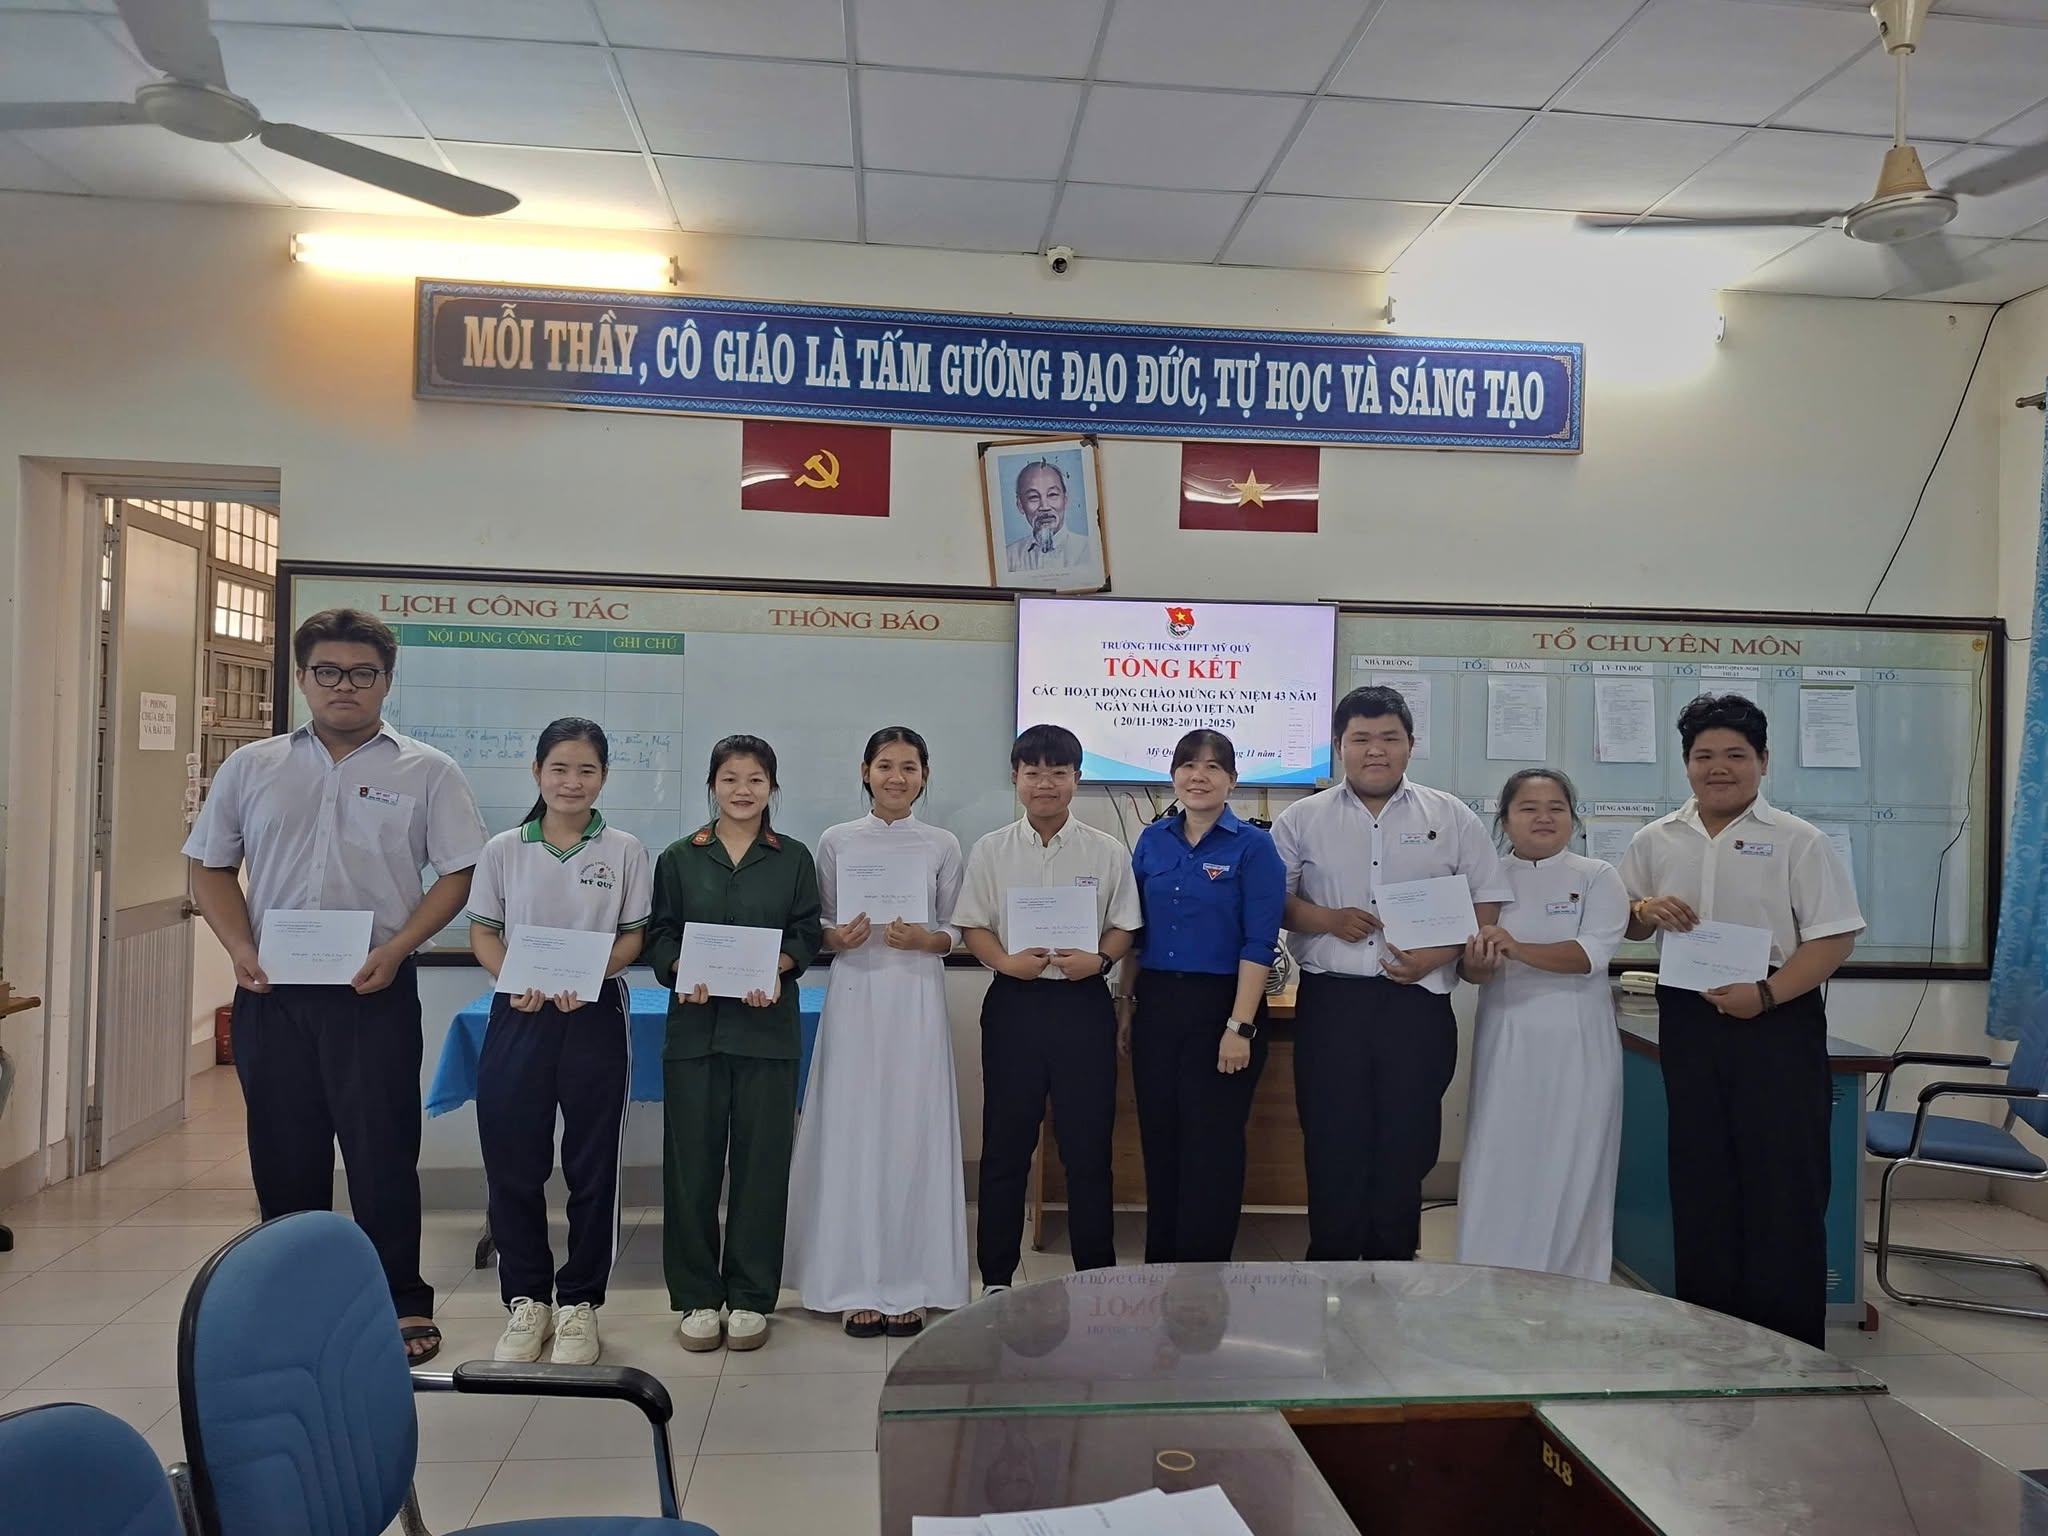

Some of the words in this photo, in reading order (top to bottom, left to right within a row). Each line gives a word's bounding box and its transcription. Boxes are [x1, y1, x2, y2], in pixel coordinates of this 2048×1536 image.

[463, 304, 533, 368] MỖI
[544, 309, 647, 385] THẦY,
[656, 319, 701, 379] CÔ
[713, 322, 795, 384] GIÁO
[805, 326, 851, 388] LÀ
[857, 329, 931, 393] TẤM
[940, 338, 1052, 401] GƯƠNG
[1062, 353, 1127, 411] ĐẠO
[1136, 346, 1206, 415] ĐỨC,
[1214, 352, 1260, 418] TỰ
[1266, 361, 1332, 421] HỌC
[1341, 354, 1383, 414] VÀ
[1390, 356, 1476, 418] SÁNG
[1483, 371, 1544, 429] TẠO
[380, 594, 457, 618] LỊCH
[467, 594, 559, 619] CÔNG
[567, 597, 630, 621] TÁC
[768, 606, 872, 630] THÔNG
[880, 610, 940, 631] BÁO
[427, 628, 454, 643] NỘI
[458, 631, 502, 643] DUNG
[507, 630, 550, 646] CÔNG
[557, 631, 582, 647] TÁC
[613, 636, 640, 649] GHI
[644, 634, 678, 650] CHÚ
[1101, 641, 1145, 650] TRƯỜNG
[1533, 626, 1577, 651] TỔ
[1587, 633, 1722, 655] CHUYÊN
[1731, 635, 1804, 656] MÔN
[1104, 652, 1179, 679] TỔNG
[1188, 654, 1242, 680] KẾT
[1032, 684, 1058, 696] CÁC
[1064, 687, 1099, 699] HOẠT
[1140, 686, 1175, 698] CHÀO
[1179, 687, 1216, 700] MỪNG
[1240, 690, 1271, 702] NIỆM
[1274, 691, 1286, 700] 43
[1095, 700, 1129, 712] NGÀY
[1132, 700, 1158, 712] NHÀ
[1161, 701, 1193, 713] GIÁO
[1196, 703, 1224, 715] VIỆT
[1227, 705, 1254, 714] NAM
[1542, 1440, 1573, 1487] B18
